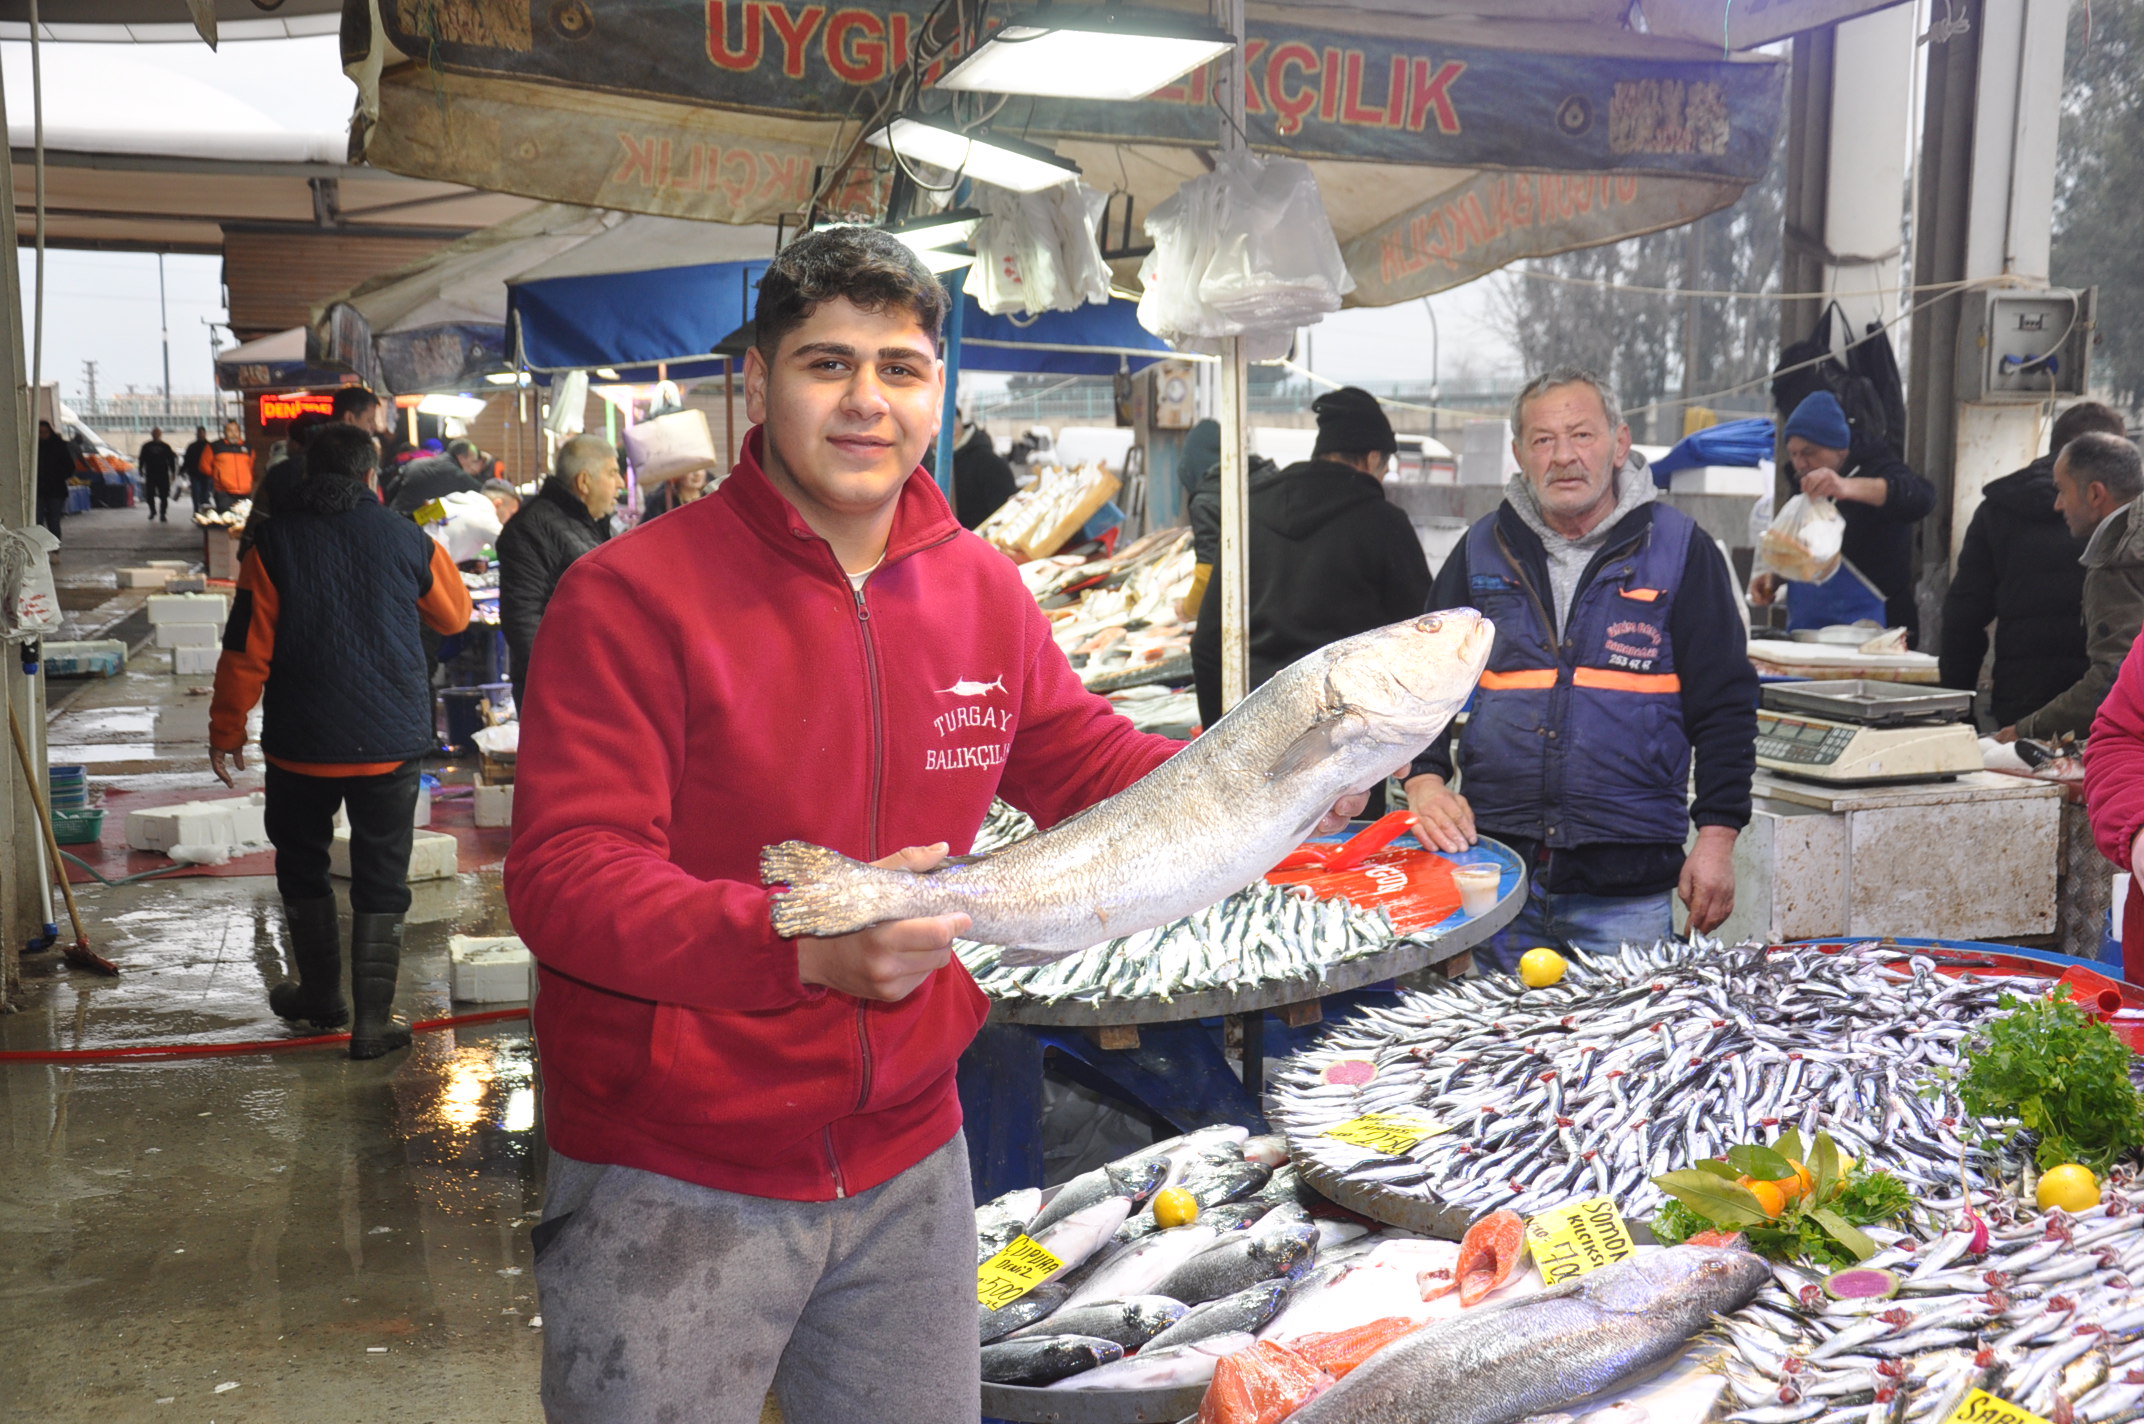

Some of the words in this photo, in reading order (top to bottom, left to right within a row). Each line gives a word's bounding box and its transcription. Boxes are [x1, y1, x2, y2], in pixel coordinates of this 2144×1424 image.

[706, 0, 1002, 89] UYGU
[933, 705, 1013, 738] TURGAY
[978, 1276, 1024, 1301] 500
